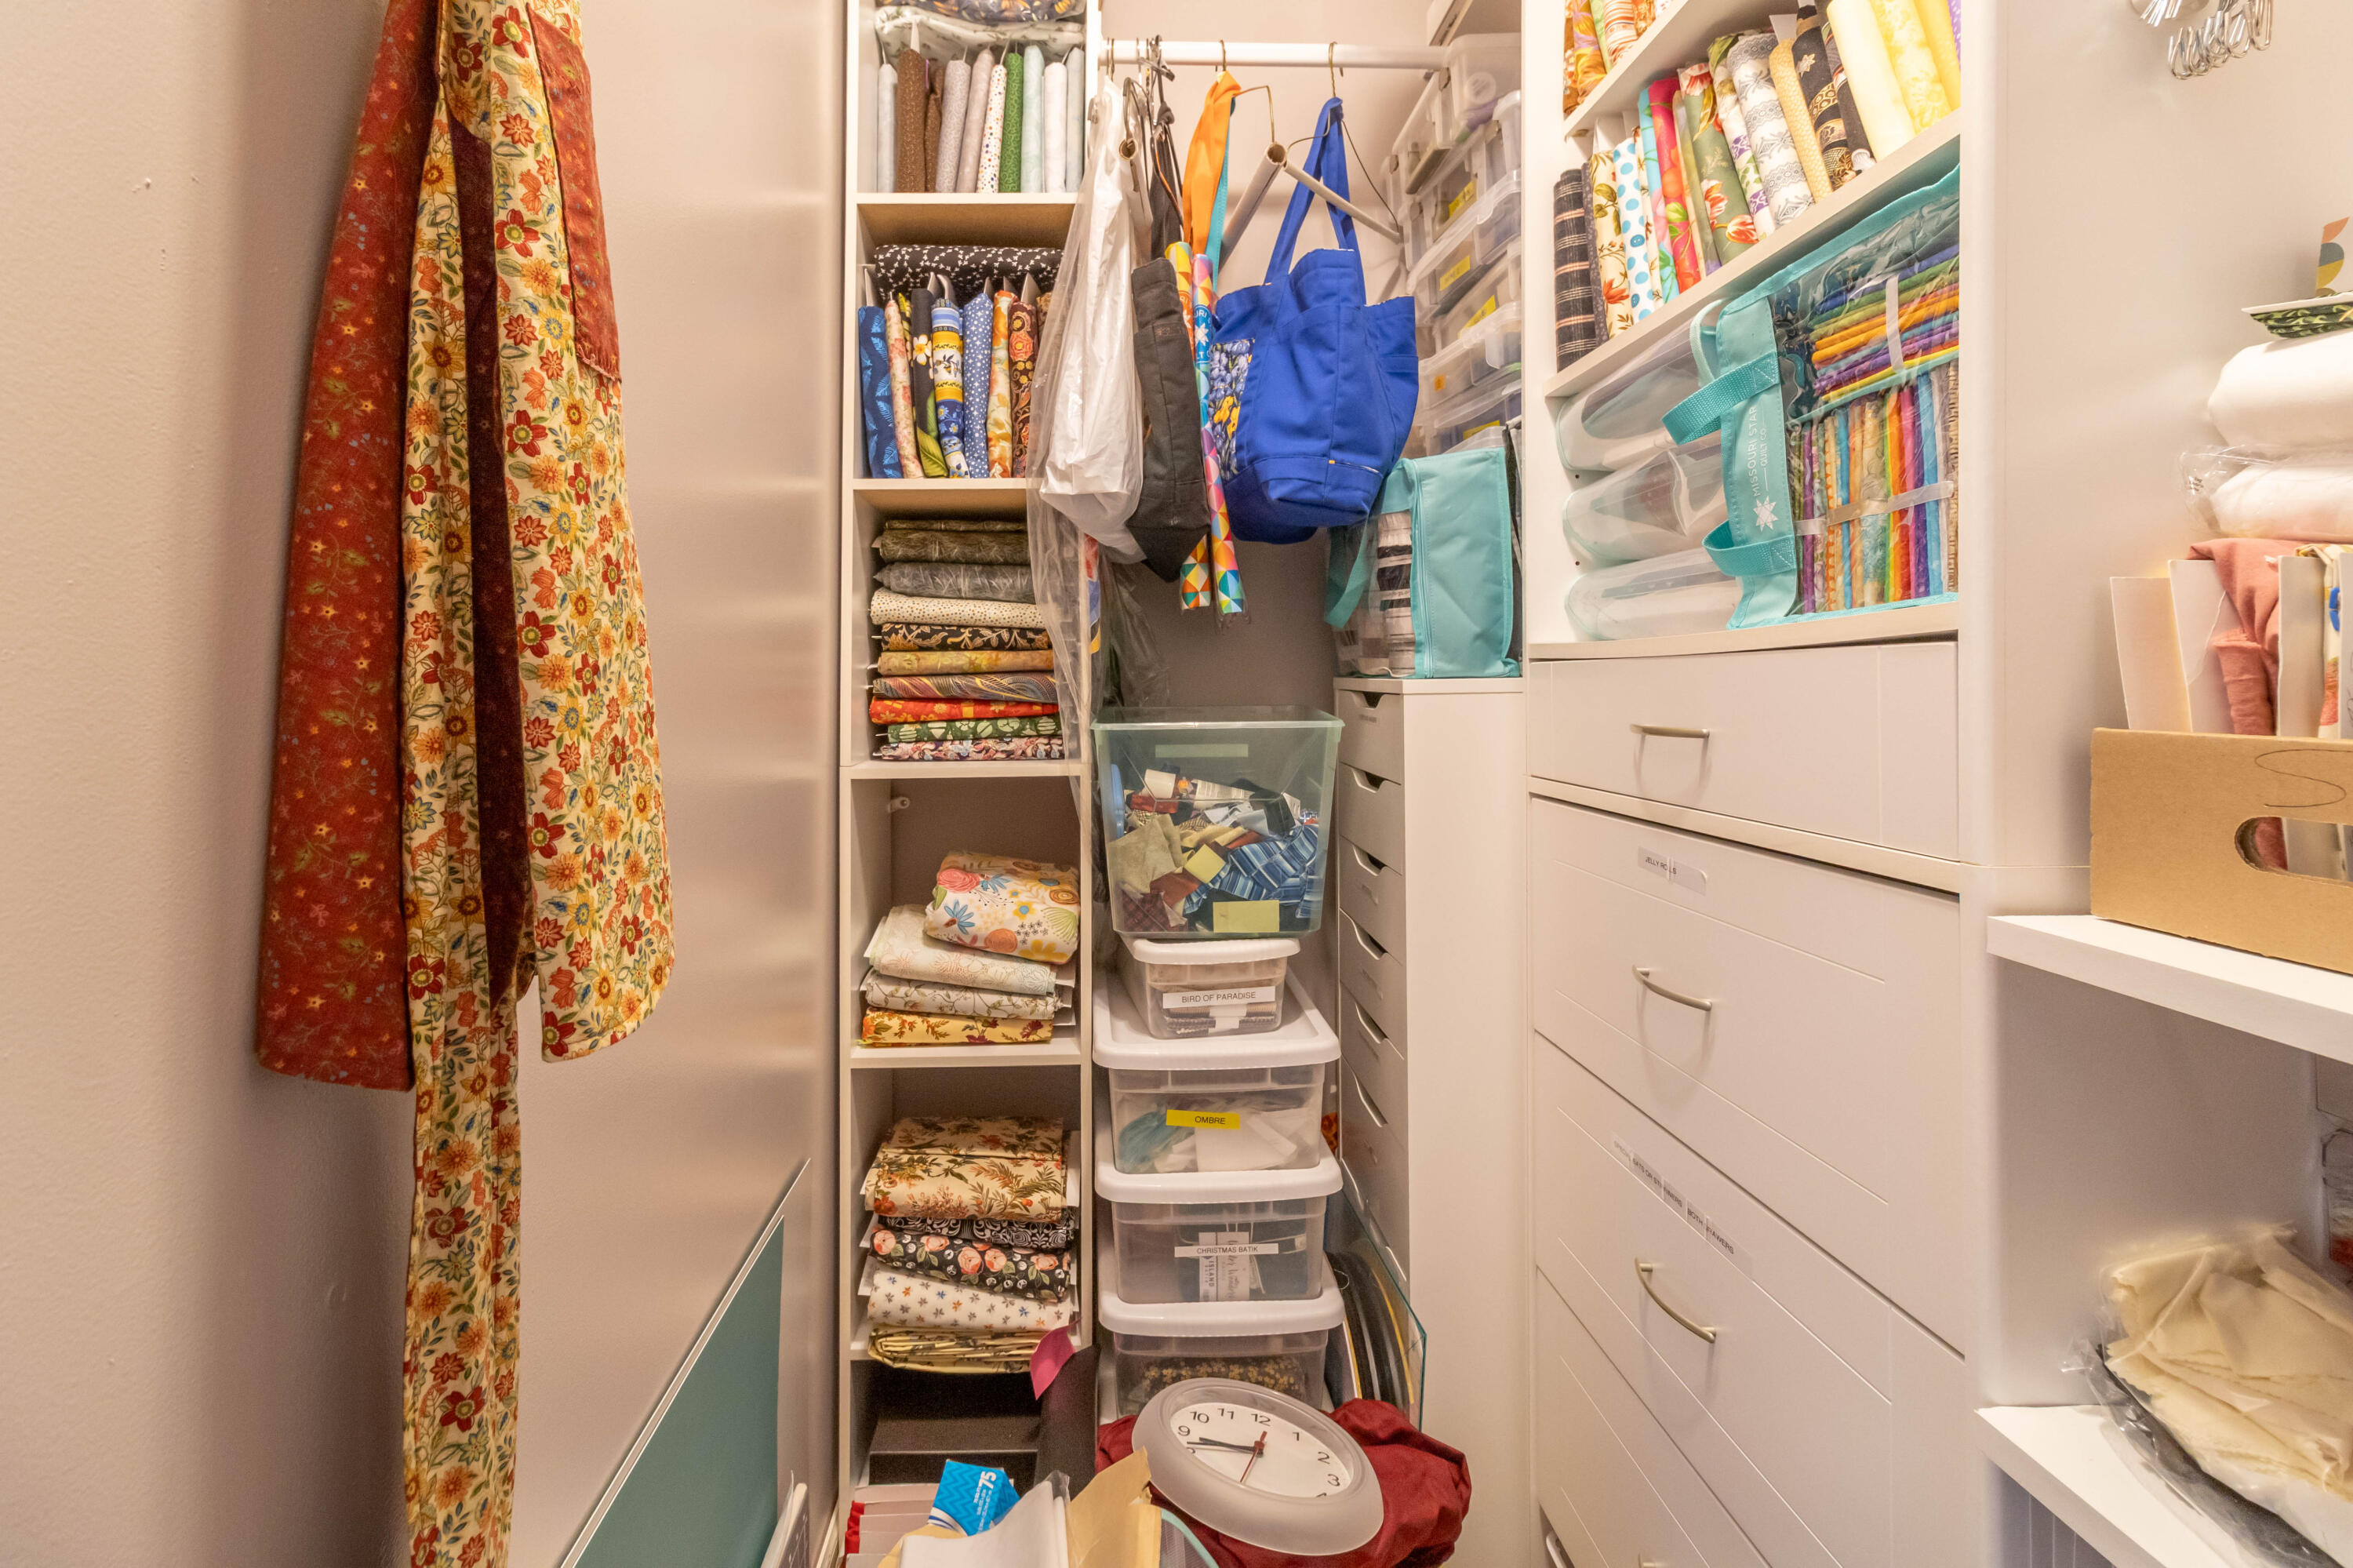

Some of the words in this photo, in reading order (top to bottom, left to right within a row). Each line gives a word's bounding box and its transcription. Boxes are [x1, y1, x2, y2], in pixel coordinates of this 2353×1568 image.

[1748, 406, 1758, 436] STAR
[1760, 442, 1769, 467] QUILT
[1747, 439, 1761, 497] MISSOURI
[1181, 995, 1202, 1003] BIRD
[1217, 991, 1257, 1001] PARADISE
[1195, 1115, 1227, 1125] OMBRE
[1196, 1246, 1238, 1255] CHRISTMAS
[1189, 1411, 1210, 1424] 10
[1217, 1408, 1235, 1420] 11
[1250, 1413, 1271, 1427] 12
[1177, 1425, 1191, 1437] 9
[1293, 1432, 1300, 1442] 1
[1317, 1451, 1331, 1464] 2
[978, 1471, 997, 1490] 75
[1327, 1473, 1341, 1486] 3
